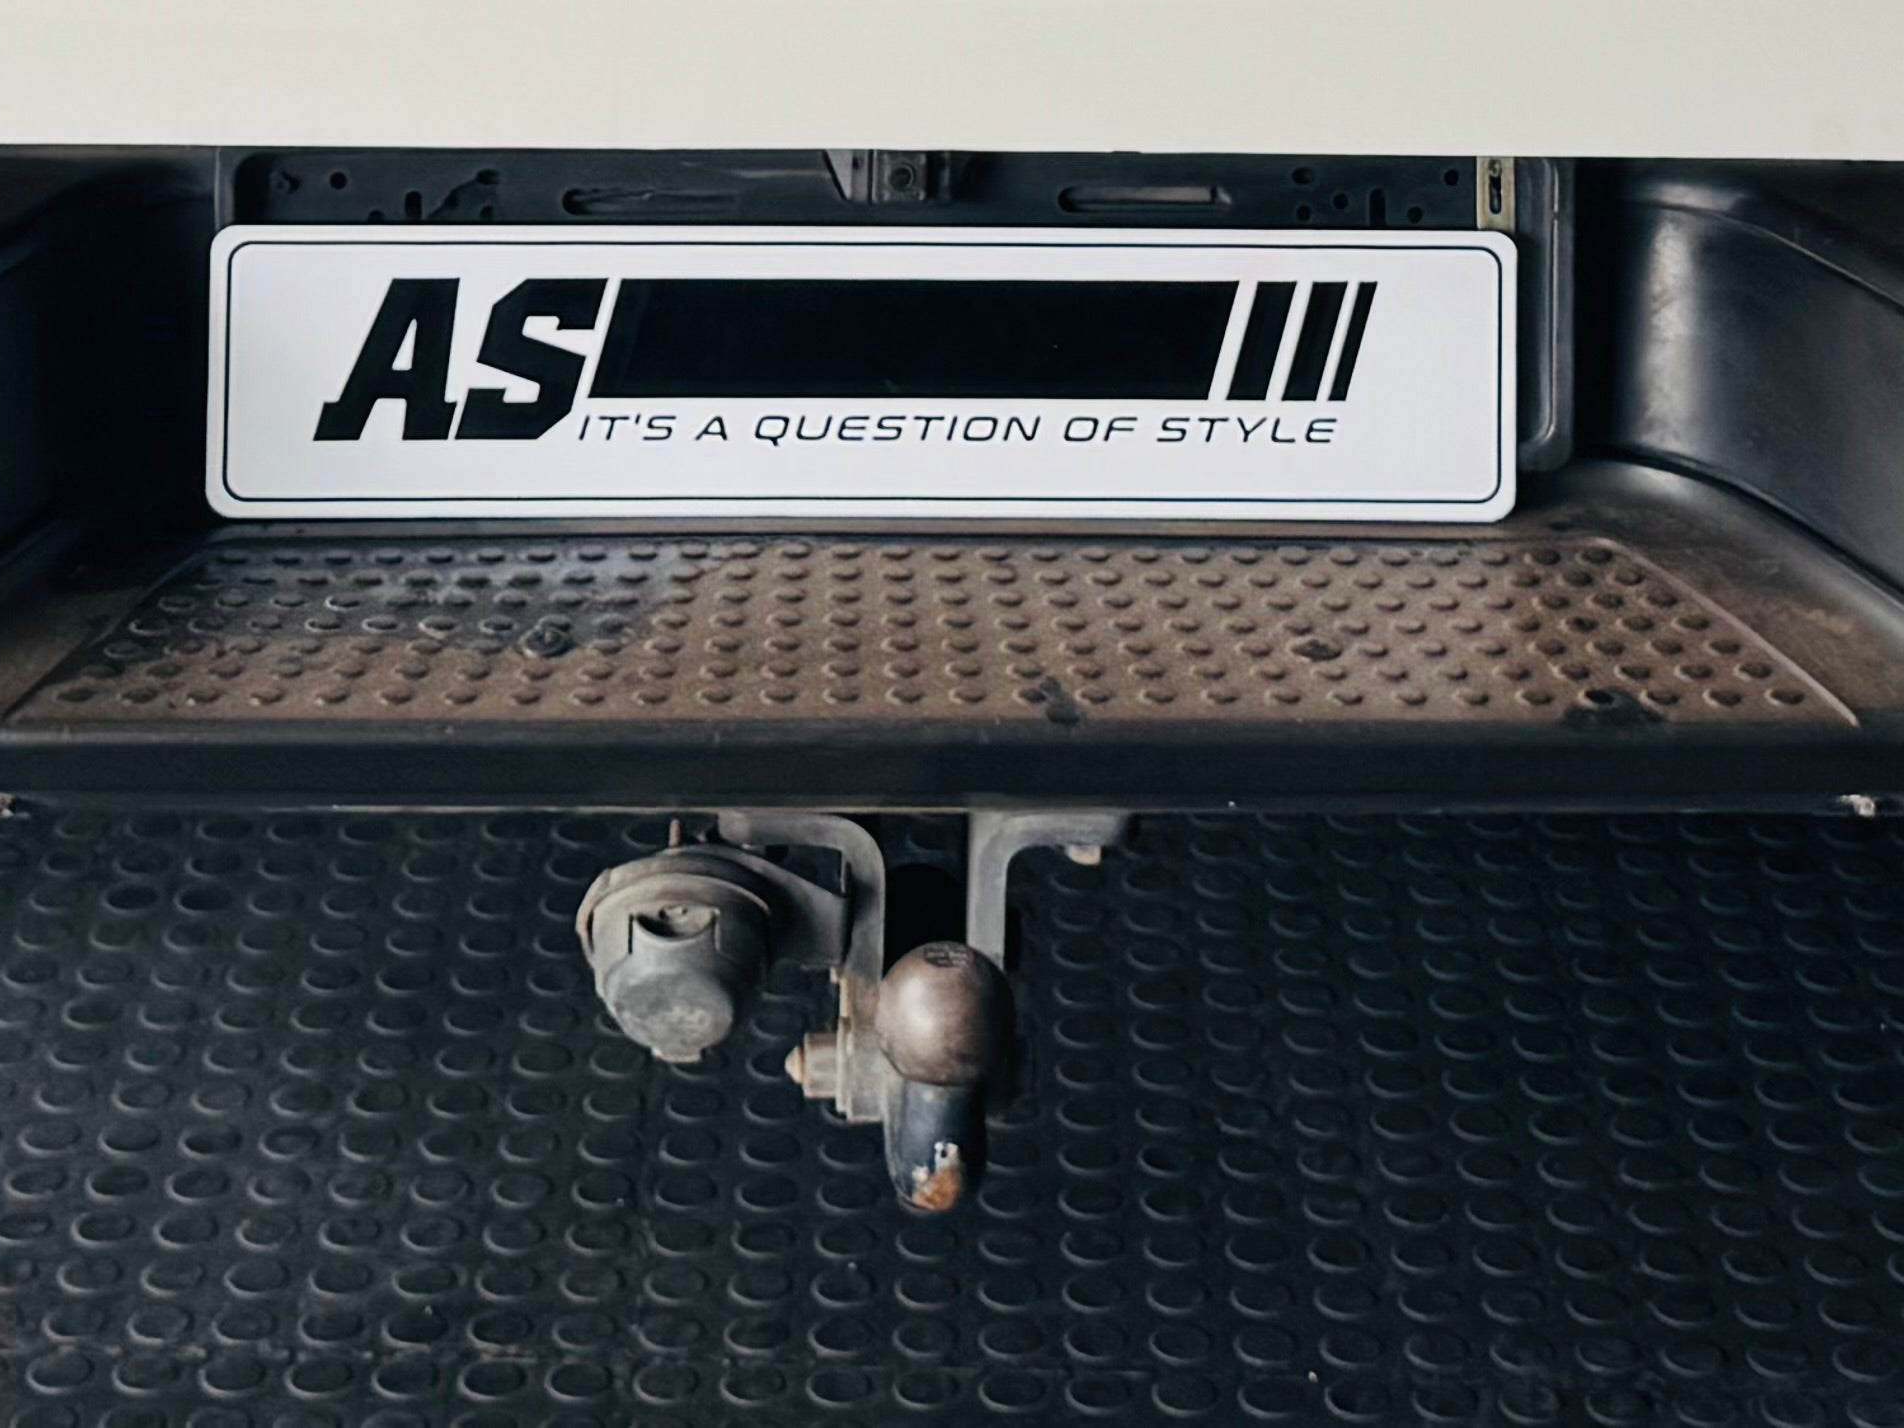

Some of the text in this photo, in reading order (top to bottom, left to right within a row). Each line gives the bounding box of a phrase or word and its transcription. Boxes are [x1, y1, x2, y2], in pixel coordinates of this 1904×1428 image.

[312, 277, 609, 441] AS
[577, 413, 1338, 448] IT'S A QUESTION OF STYLE
